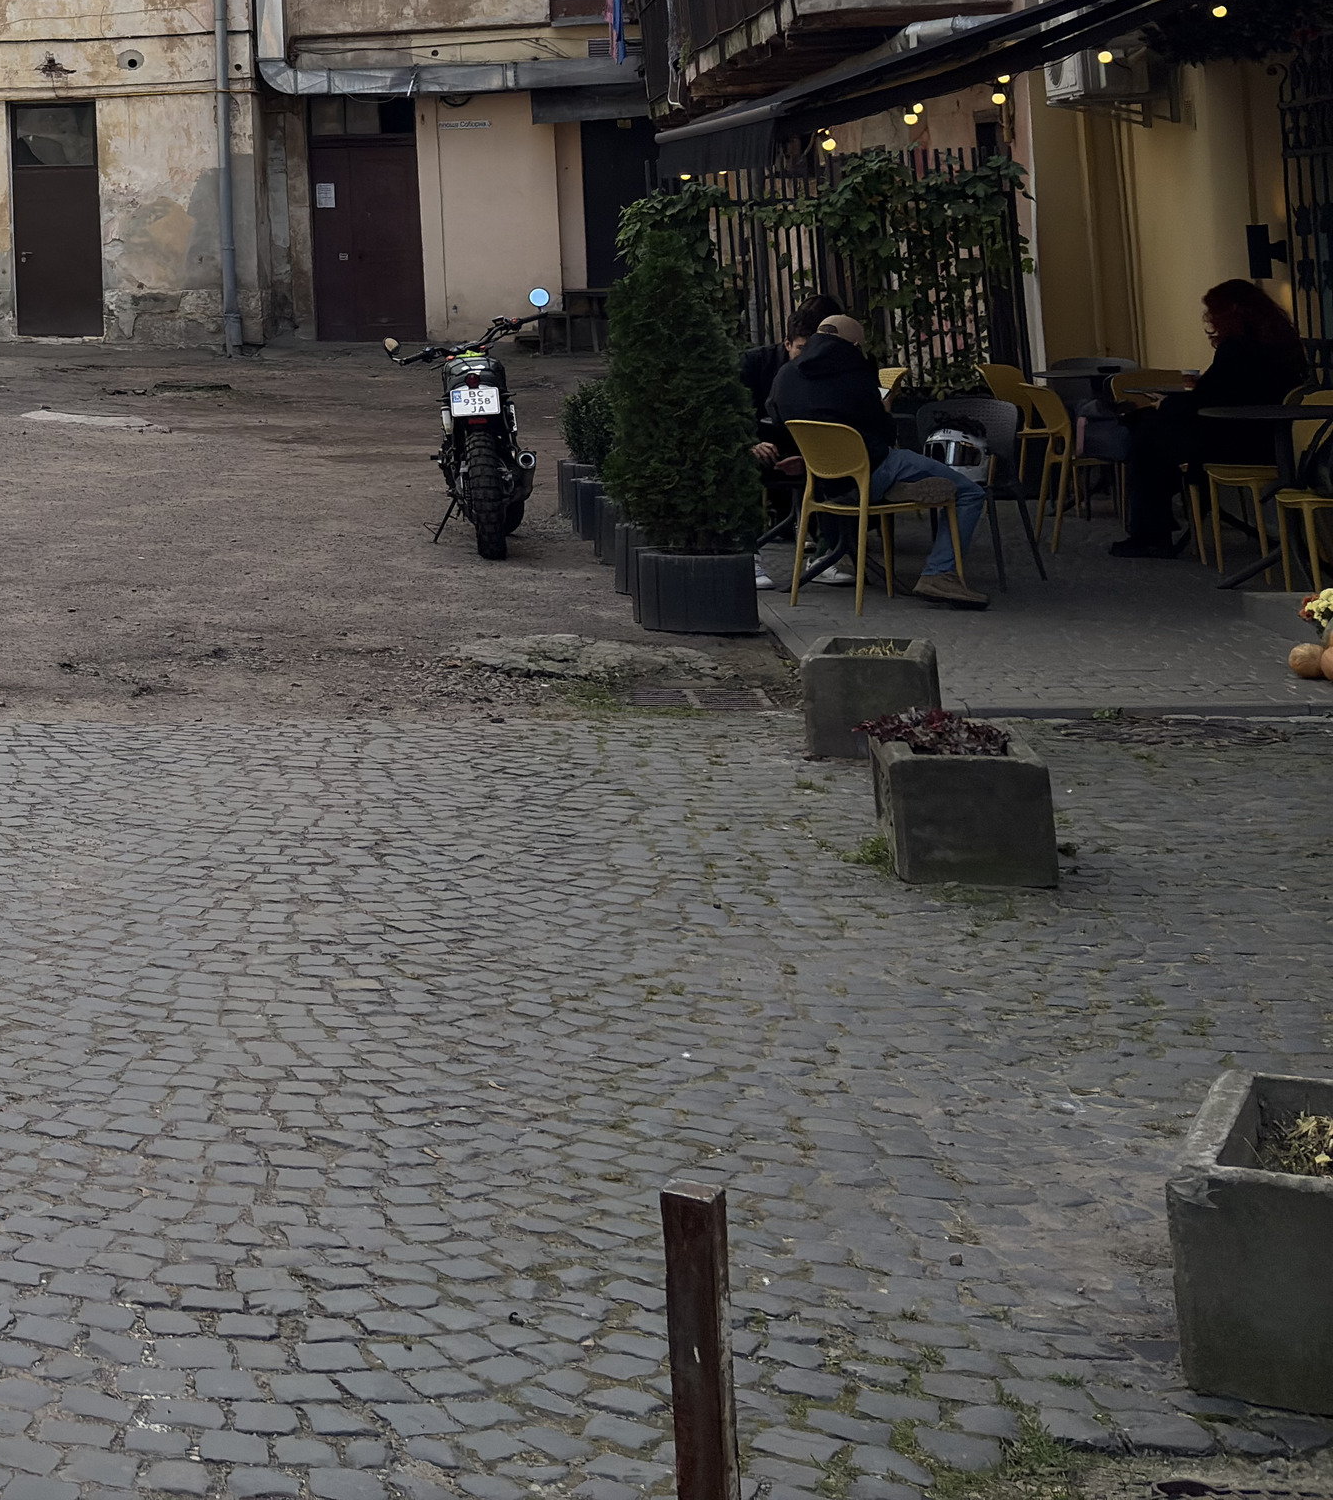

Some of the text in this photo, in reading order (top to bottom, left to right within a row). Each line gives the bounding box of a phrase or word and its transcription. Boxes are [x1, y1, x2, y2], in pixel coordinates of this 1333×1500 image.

[468, 390, 484, 398] BC
[463, 397, 491, 406] 9358
[470, 405, 486, 414] JA
